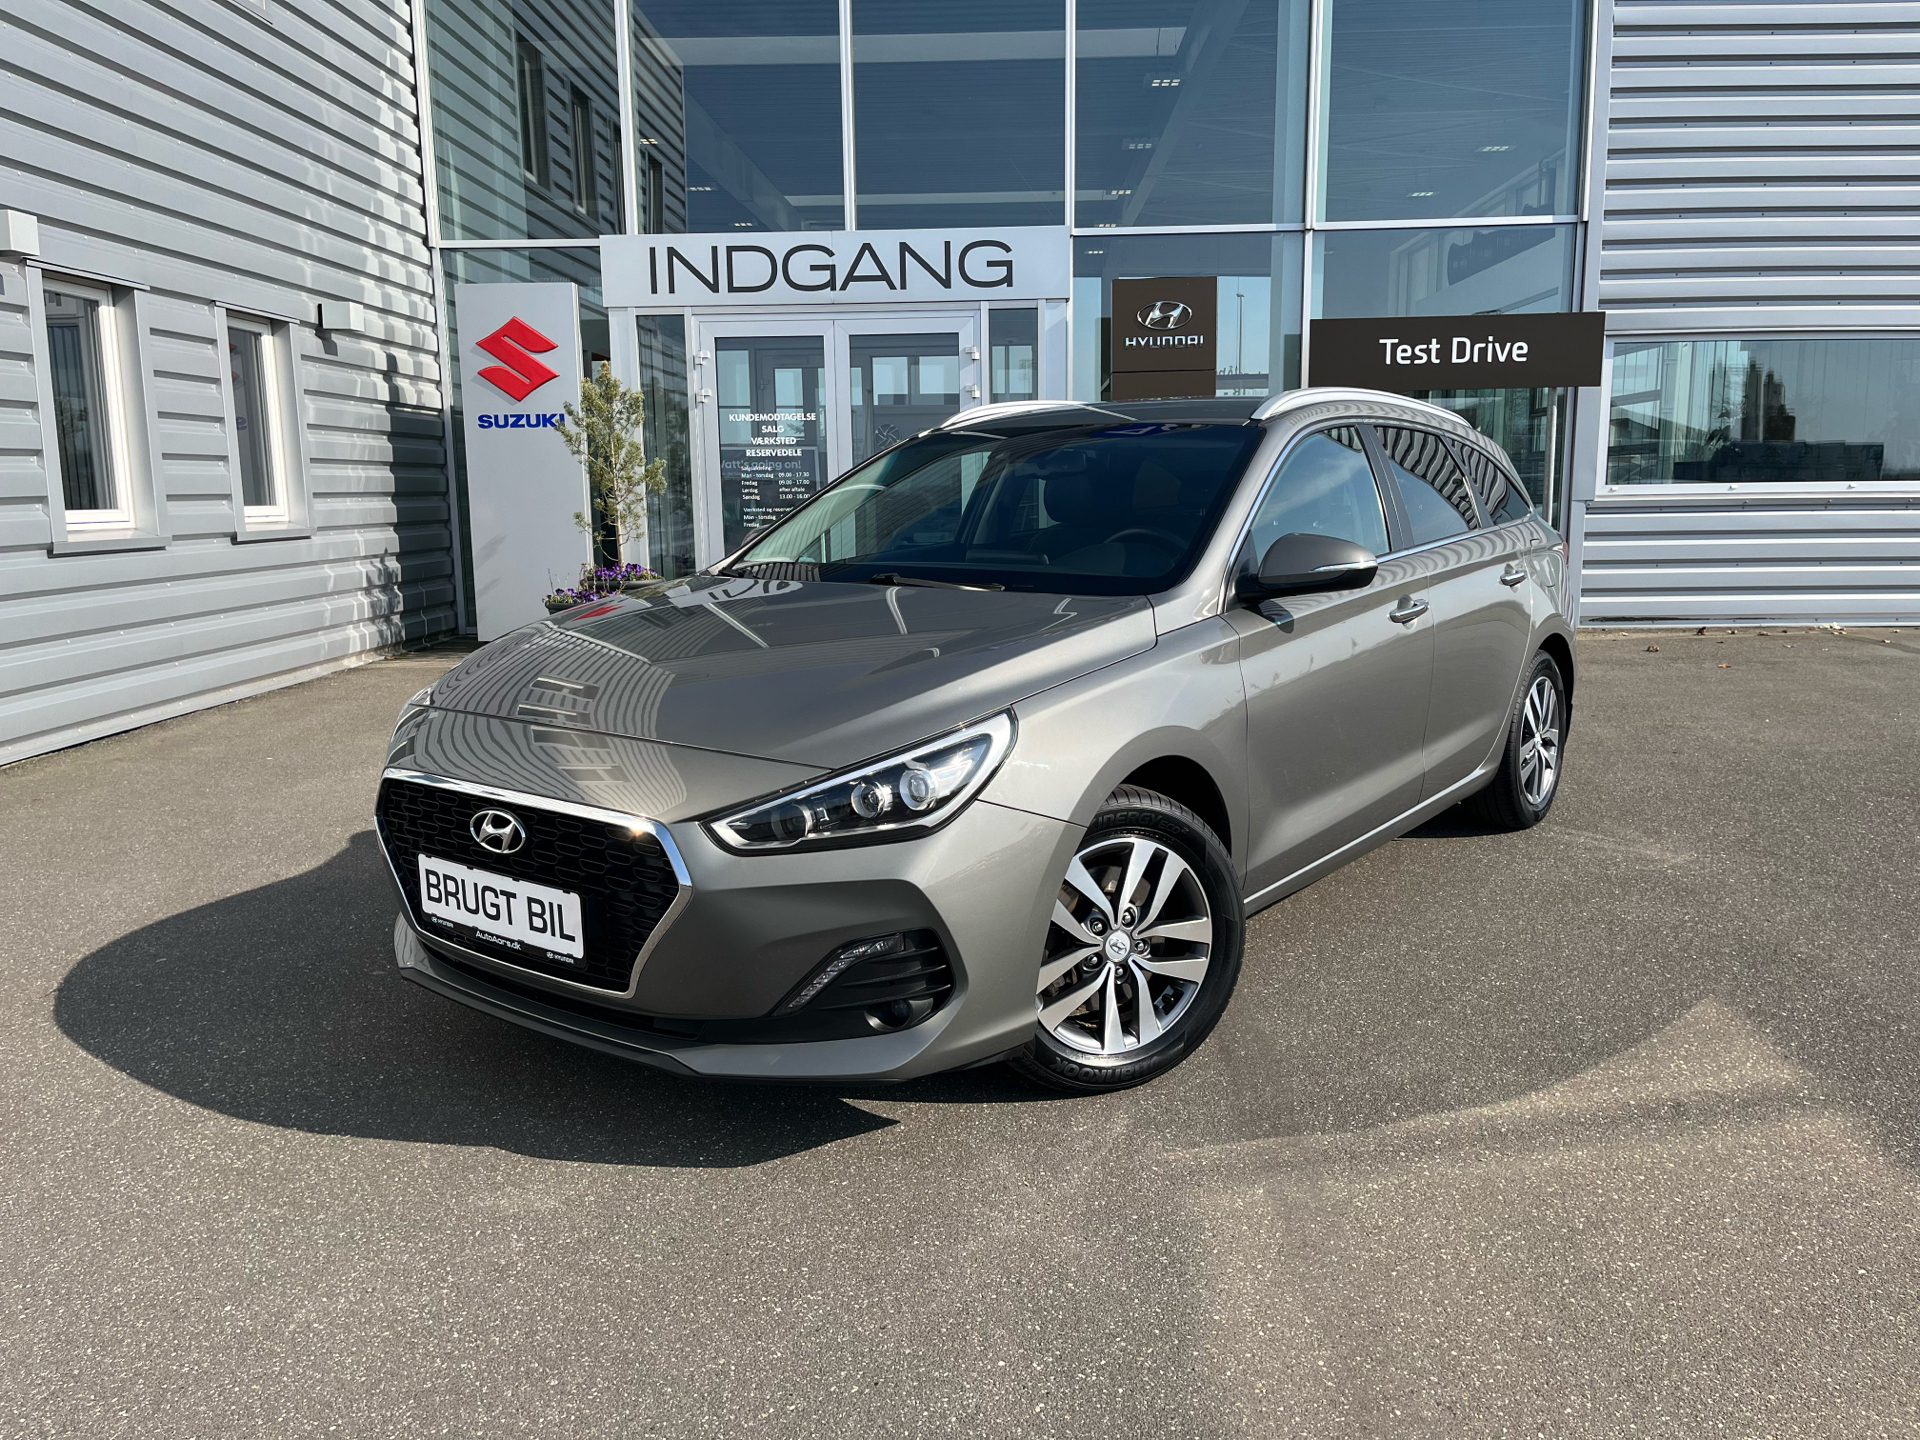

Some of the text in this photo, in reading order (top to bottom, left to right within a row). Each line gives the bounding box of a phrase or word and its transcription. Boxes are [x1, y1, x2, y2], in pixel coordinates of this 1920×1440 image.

[649, 240, 1014, 294] INDGANG
[1125, 335, 1204, 349] HYUNDAI
[1379, 335, 1529, 365] Test Drive
[477, 413, 565, 429] SUZUKI
[729, 413, 816, 421] KUNDEMODTAGELSE
[761, 425, 784, 433] SALG
[751, 437, 796, 445] VÆRKSTED
[746, 449, 802, 457] RESERVEDELE
[751, 460, 782, 470] going
[784, 460, 802, 469] on!
[425, 869, 576, 943] BRUGT BIL
